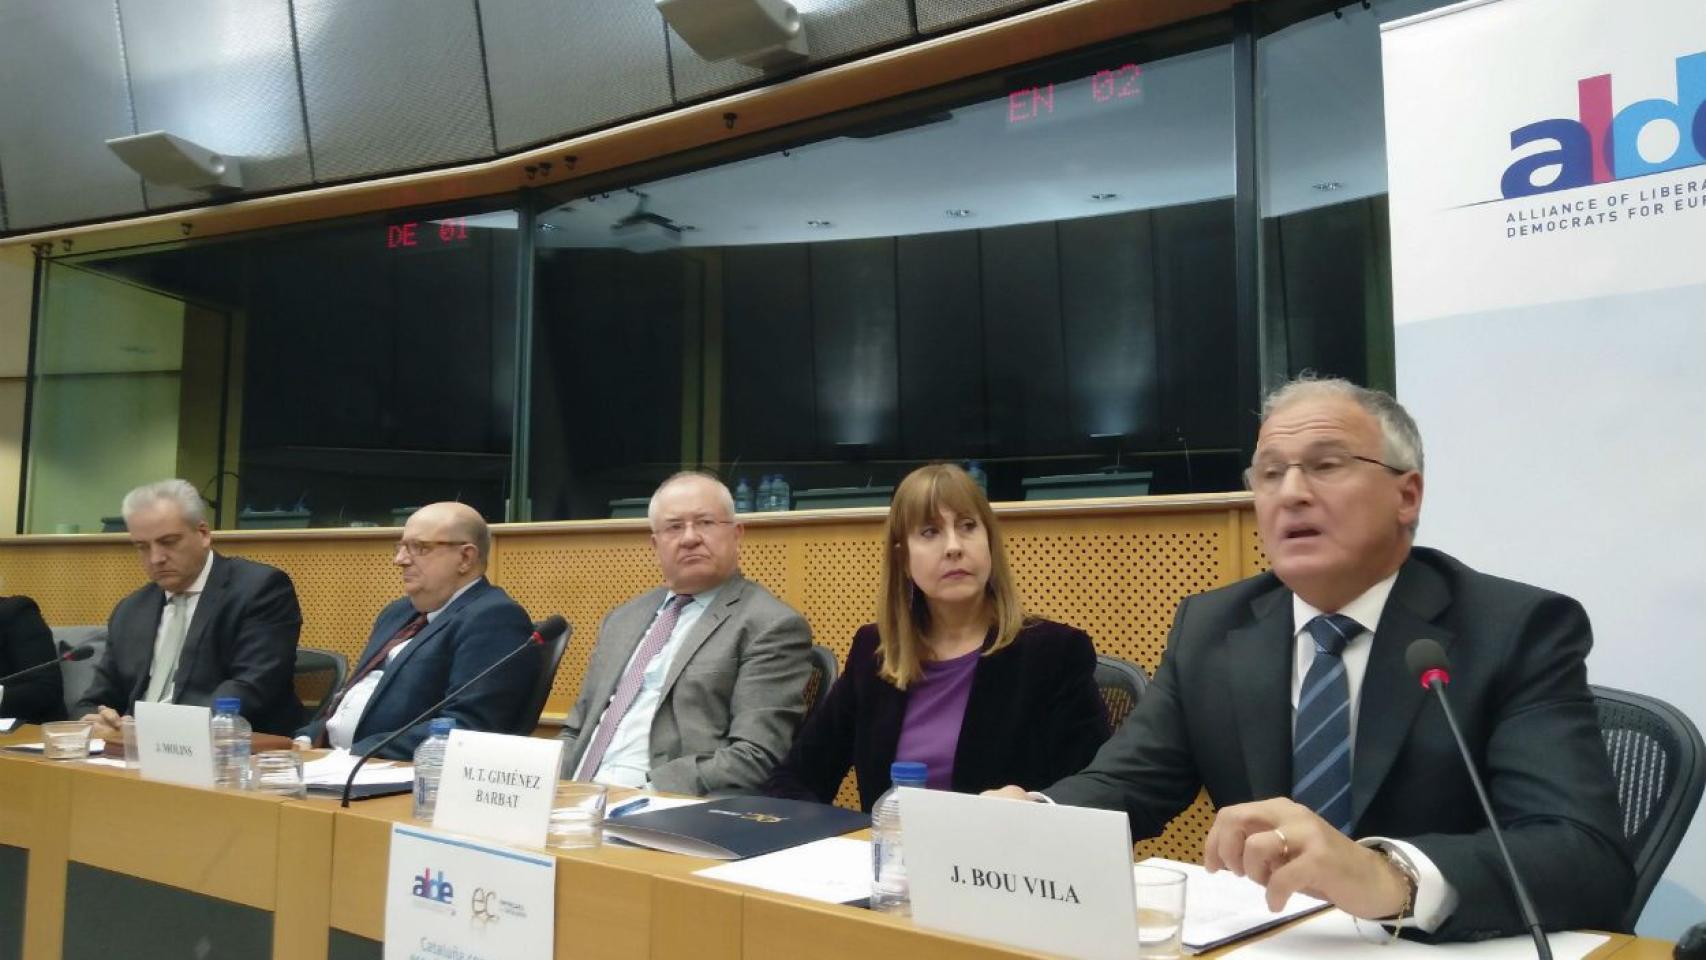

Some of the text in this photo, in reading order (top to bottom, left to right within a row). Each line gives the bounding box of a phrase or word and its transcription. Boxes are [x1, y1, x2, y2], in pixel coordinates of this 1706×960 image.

[1008, 63, 1143, 123] EN 02
[1501, 51, 1706, 200] ald
[1506, 198, 1598, 224] ALLIANCE
[1607, 193, 1630, 207] OF
[1507, 211, 1618, 238] DEMOCRATS
[1628, 203, 1665, 220] FOR
[387, 217, 467, 248] DE 01
[163, 743, 192, 757] MOLINS
[464, 766, 475, 780] M.
[488, 769, 542, 790] GIMÉNEZ
[475, 789, 520, 808] BARBAT
[412, 867, 454, 905] alde
[950, 865, 1081, 904] J. BOU VILA
